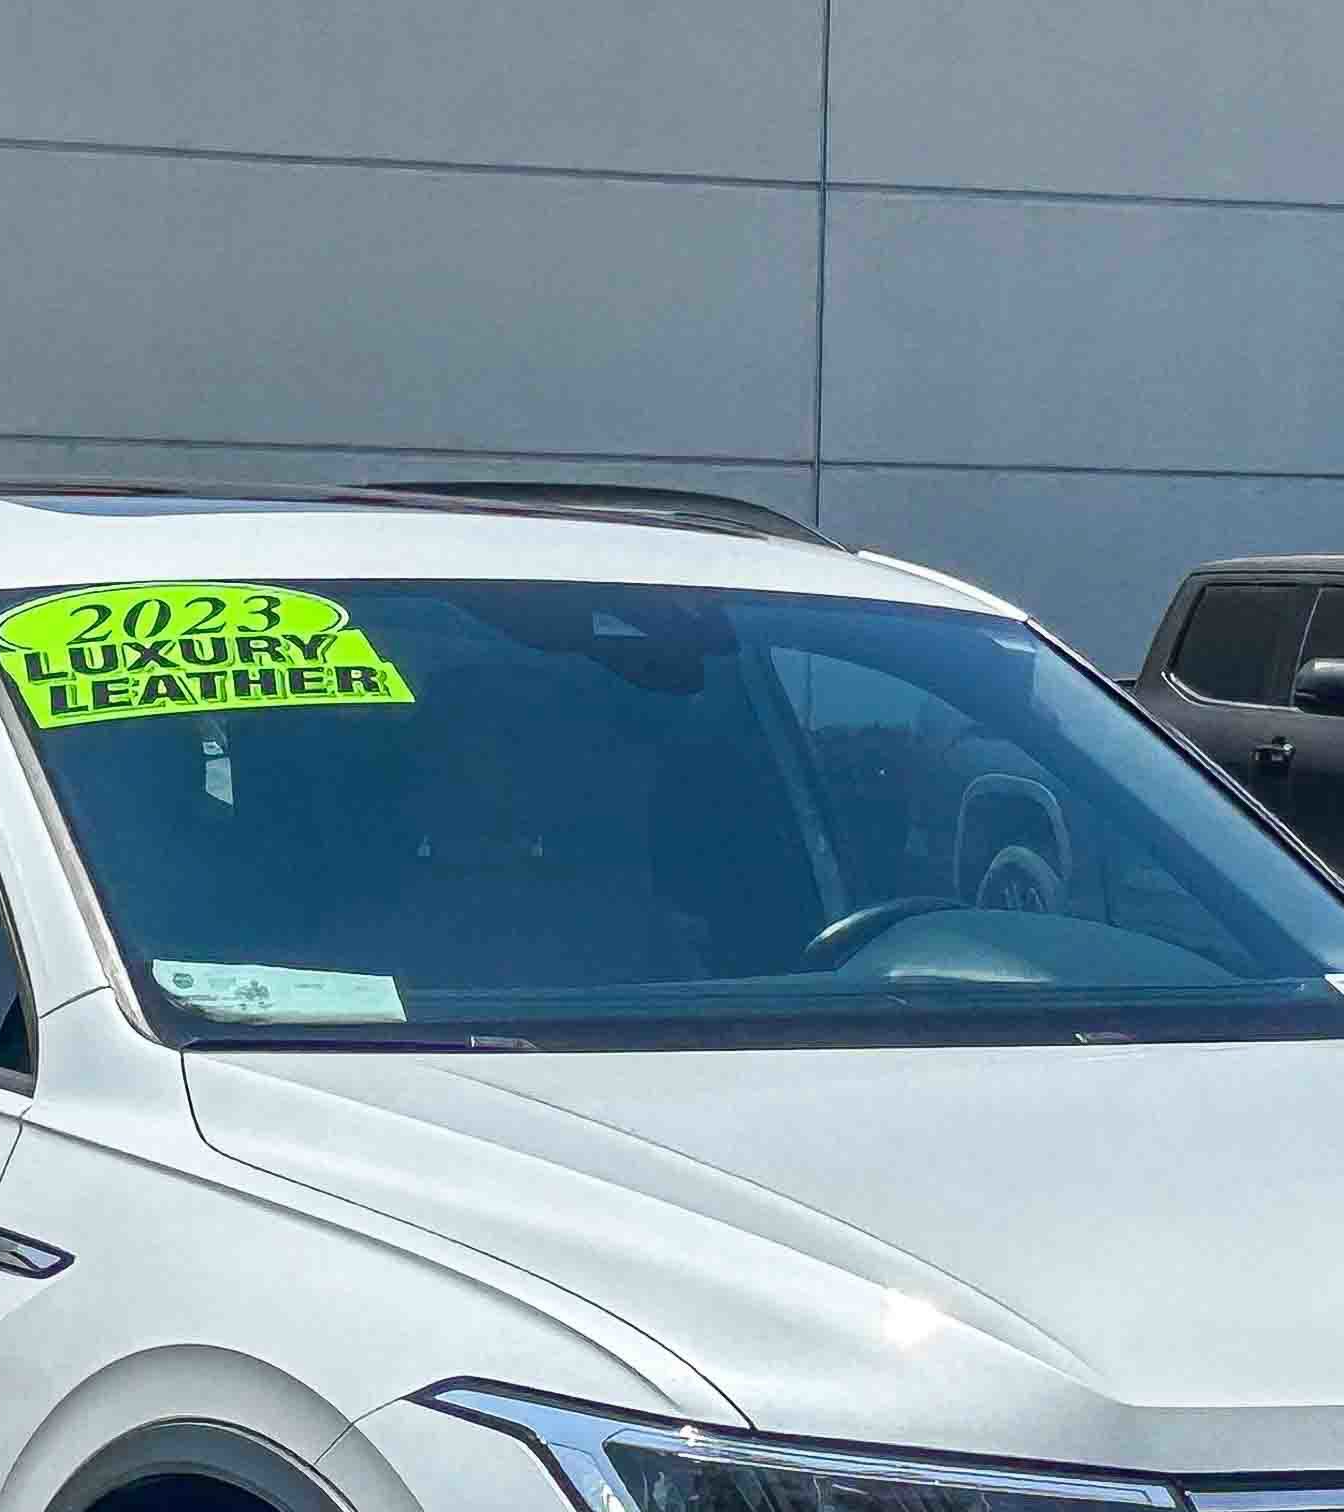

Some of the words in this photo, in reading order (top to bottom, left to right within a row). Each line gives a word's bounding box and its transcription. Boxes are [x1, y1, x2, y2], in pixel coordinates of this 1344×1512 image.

[66, 595, 282, 646] 2023
[24, 633, 337, 684] LUXURY
[49, 663, 391, 716] LEATHER
